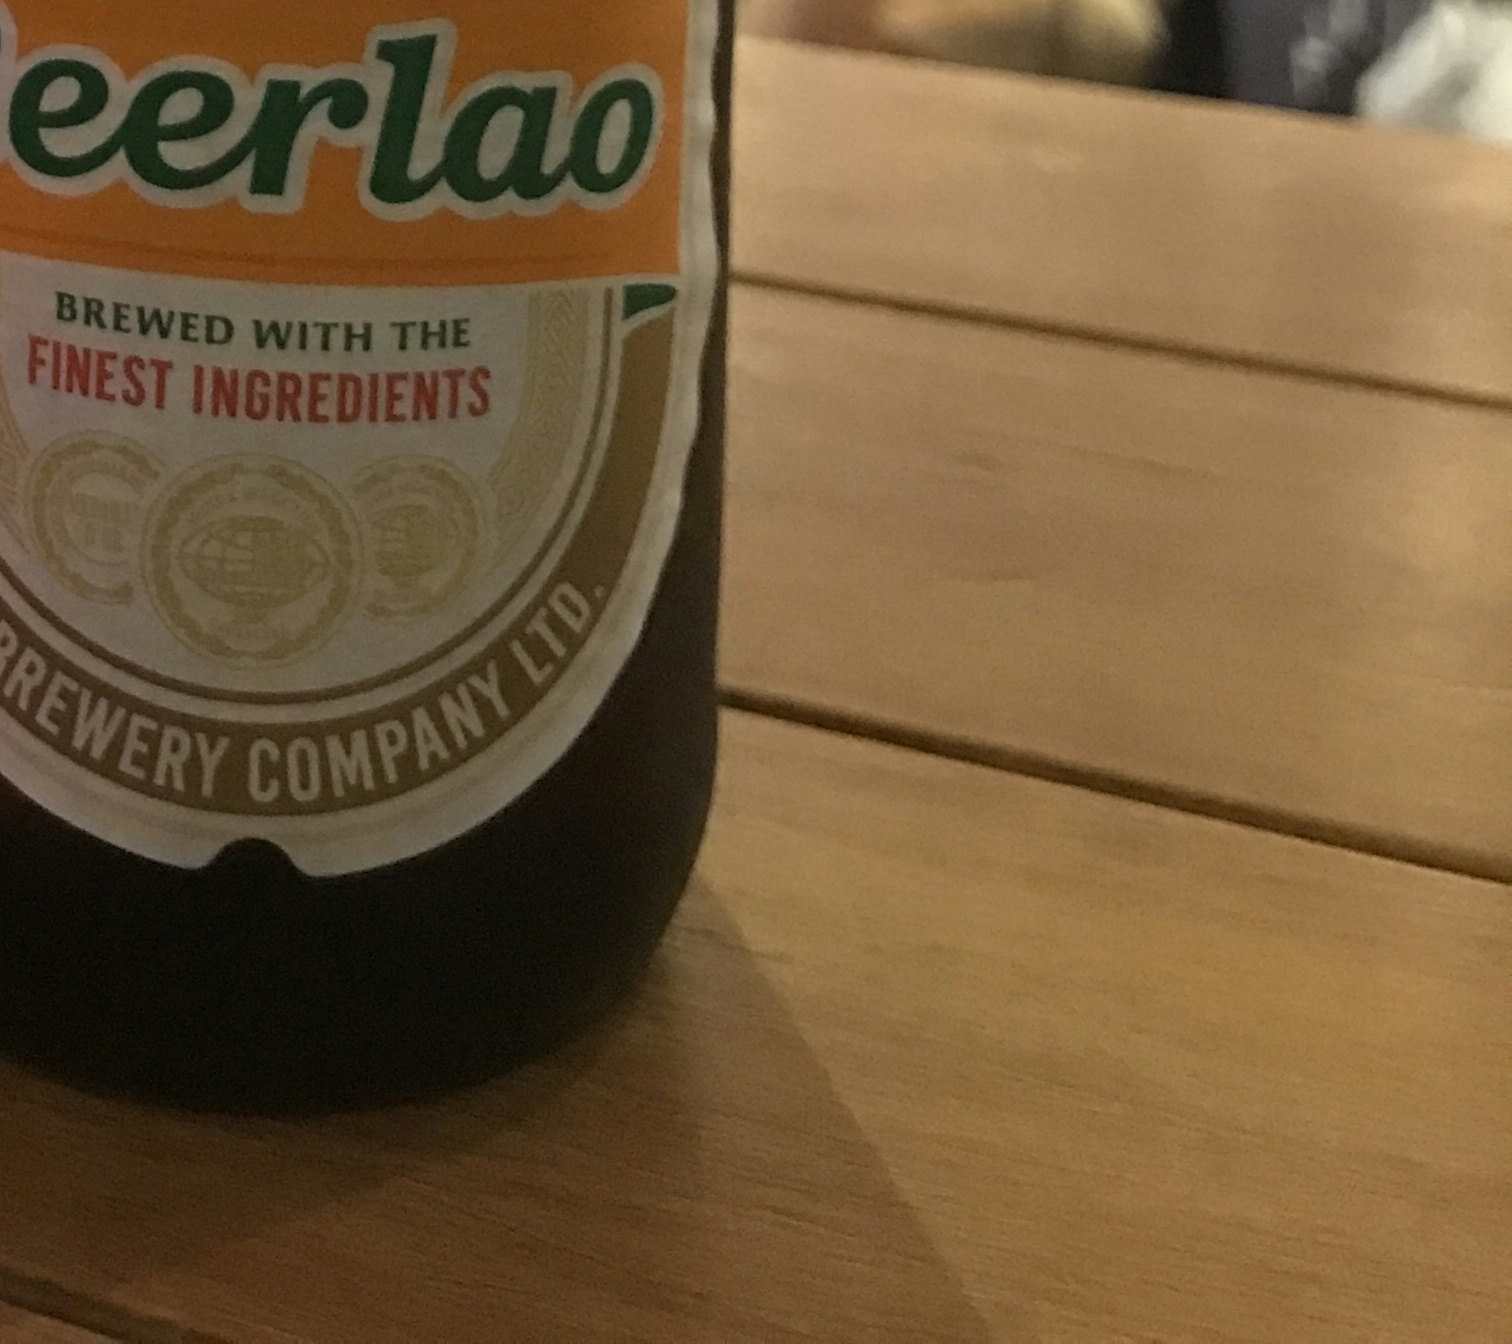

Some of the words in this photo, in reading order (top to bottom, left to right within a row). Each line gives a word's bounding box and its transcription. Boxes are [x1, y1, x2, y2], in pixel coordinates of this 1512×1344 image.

[55, 290, 235, 347] BREWED
[253, 317, 372, 353] WITH
[392, 317, 472, 350] THE
[27, 334, 173, 411] FINEST
[192, 365, 492, 426] INGREDIENTS
[247, 674, 514, 804] COMPANY
[515, 581, 606, 691] LTD.
